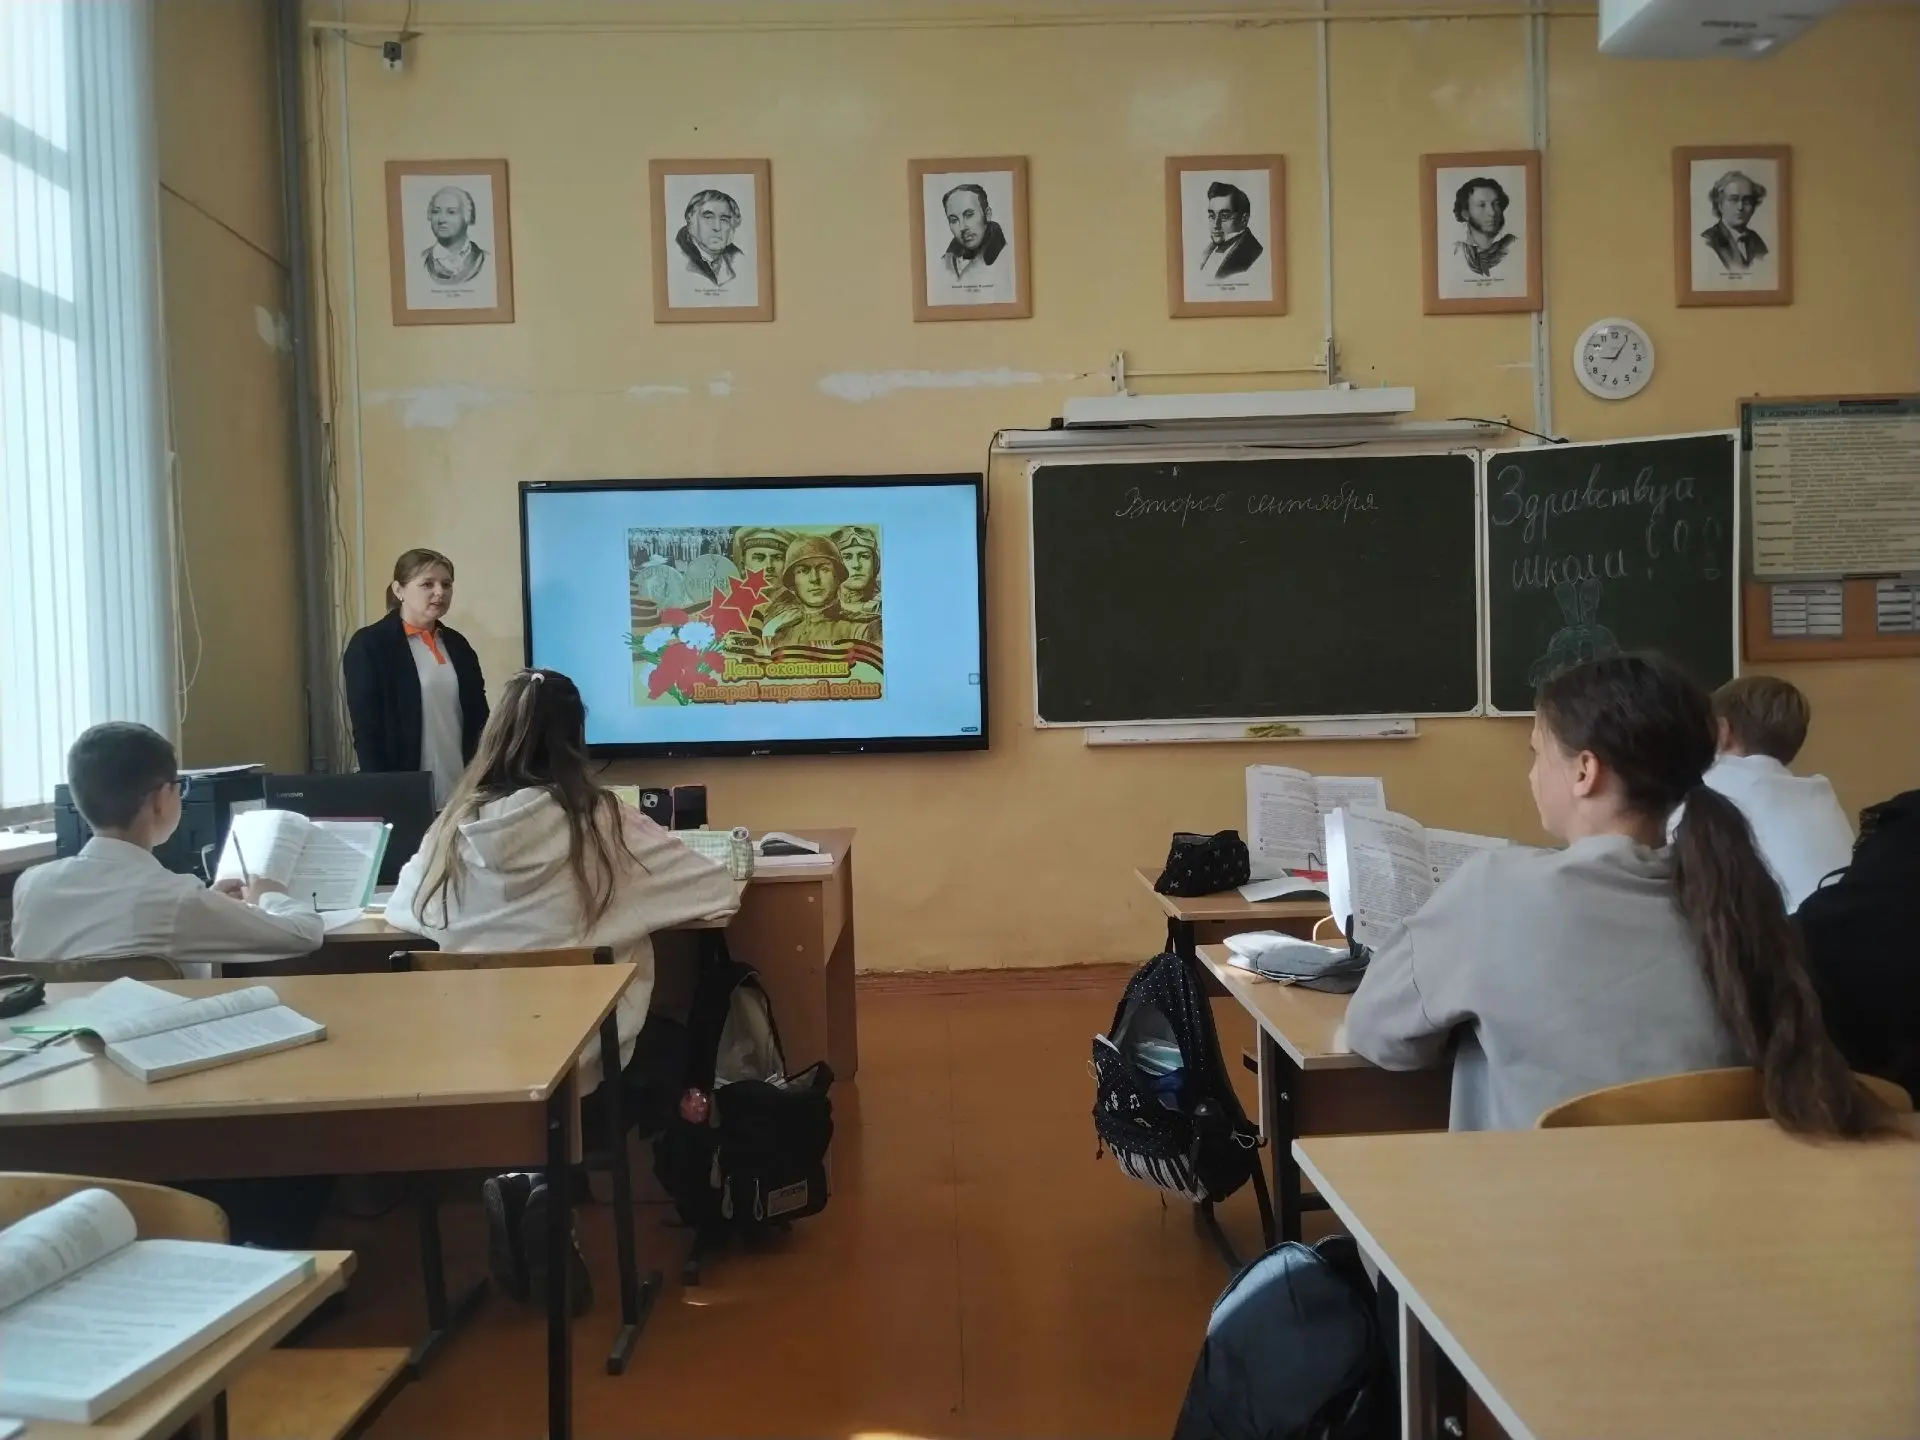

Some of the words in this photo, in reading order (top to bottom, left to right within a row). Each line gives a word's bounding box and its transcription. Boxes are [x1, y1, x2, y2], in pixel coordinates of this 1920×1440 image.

[1610, 331, 1619, 340] 12
[1601, 374, 1607, 382] 7
[1115, 486, 1227, 527] Второе
[1247, 480, 1379, 524] сентября
[724, 659, 763, 681] День
[766, 660, 850, 678] окончания
[693, 682, 759, 703] Второй
[760, 680, 829, 702] мировой
[830, 680, 880, 698] войны
